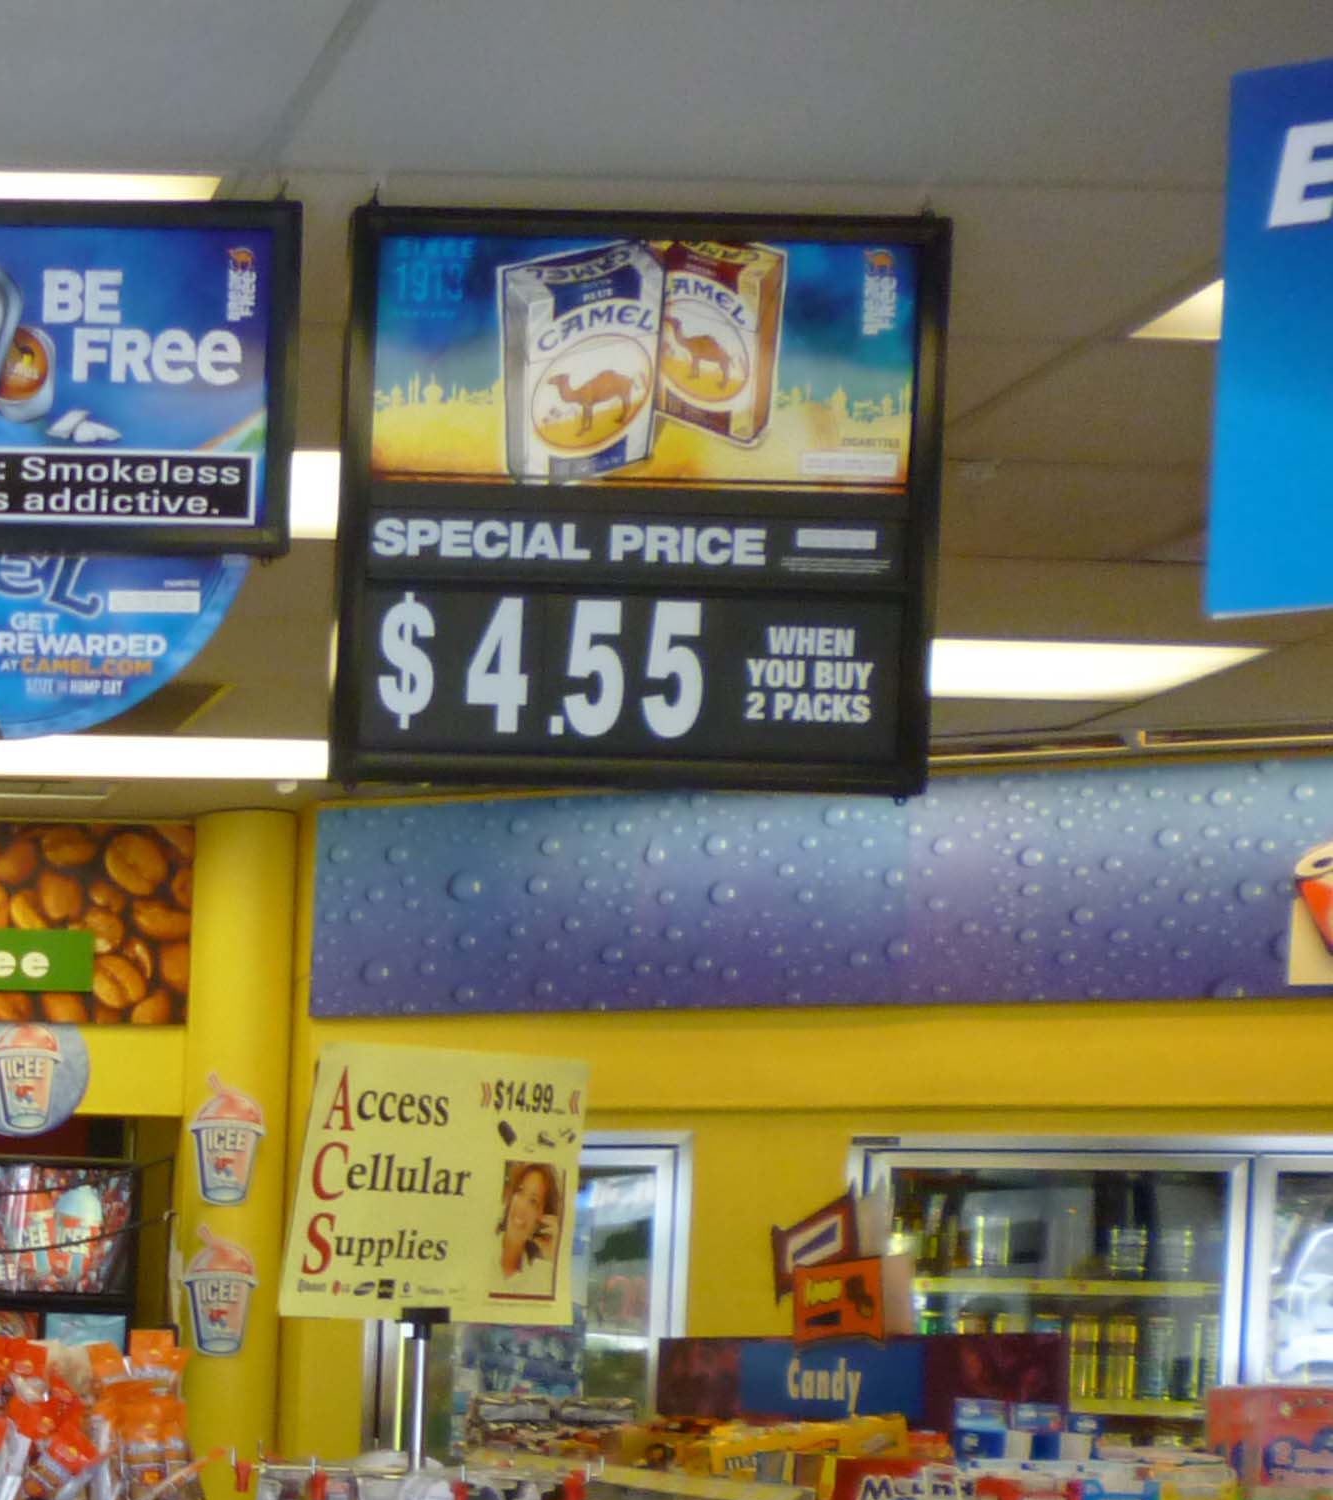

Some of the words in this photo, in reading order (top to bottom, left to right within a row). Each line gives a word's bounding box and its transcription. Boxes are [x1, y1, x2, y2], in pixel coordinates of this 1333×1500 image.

[42, 269, 123, 325] BE
[664, 277, 748, 327] AMEL
[537, 301, 657, 351] CAMEL
[21, 456, 242, 487] Smokeless
[22, 486, 221, 518] addictive.
[372, 517, 592, 562] SPECIAL
[610, 525, 767, 567] PRICE
[10, 612, 59, 633] GET
[767, 626, 857, 658] WHEN
[0, 659, 20, 672] AT
[20, 657, 153, 676] CAMEL.COM
[746, 657, 803, 690] YOU
[814, 660, 874, 691] BUY
[745, 692, 767, 721] 2
[772, 692, 873, 724] PACKS
[5, 1058, 46, 1079] ICEE
[322, 1065, 450, 1132] Access
[493, 1079, 555, 1114] $14.99
[205, 1128, 246, 1151] ICEE
[311, 1140, 472, 1202] Cellular
[300, 1211, 449, 1276] Supplies
[200, 1280, 242, 1302] ICEE
[788, 1357, 862, 1416] Candy
